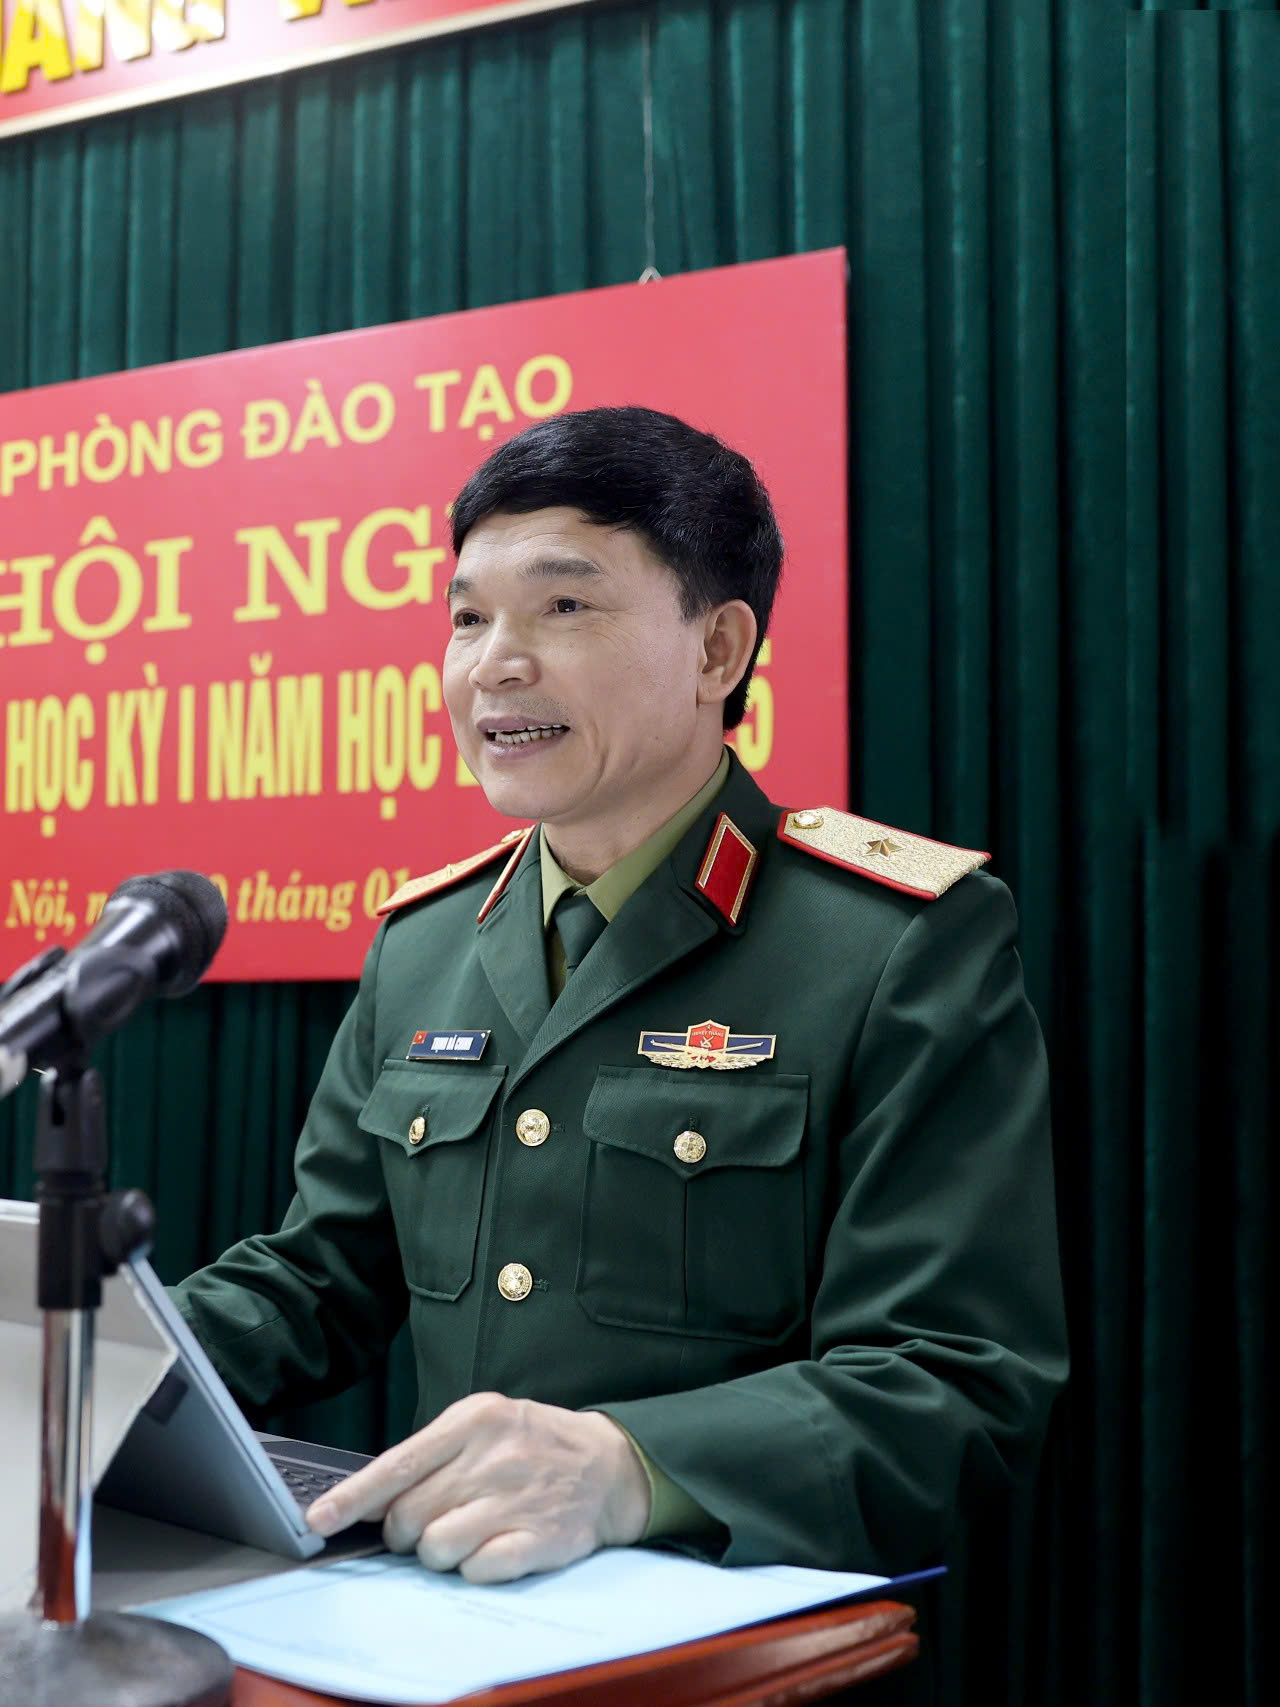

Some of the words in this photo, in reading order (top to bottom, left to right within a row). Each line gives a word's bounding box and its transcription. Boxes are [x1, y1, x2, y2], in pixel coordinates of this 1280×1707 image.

[0, 414, 223, 496] PHÒNG
[242, 380, 395, 459] ĐÀO
[415, 355, 573, 440] TẠO
[233, 503, 455, 622] NG
[5, 692, 95, 838] HỌC
[106, 661, 167, 807] KỲ
[178, 683, 195, 803] I
[207, 651, 323, 801] NĂM
[337, 662, 442, 820] HỌC
[5, 878, 76, 942] Nội,
[236, 869, 357, 932] tháng
